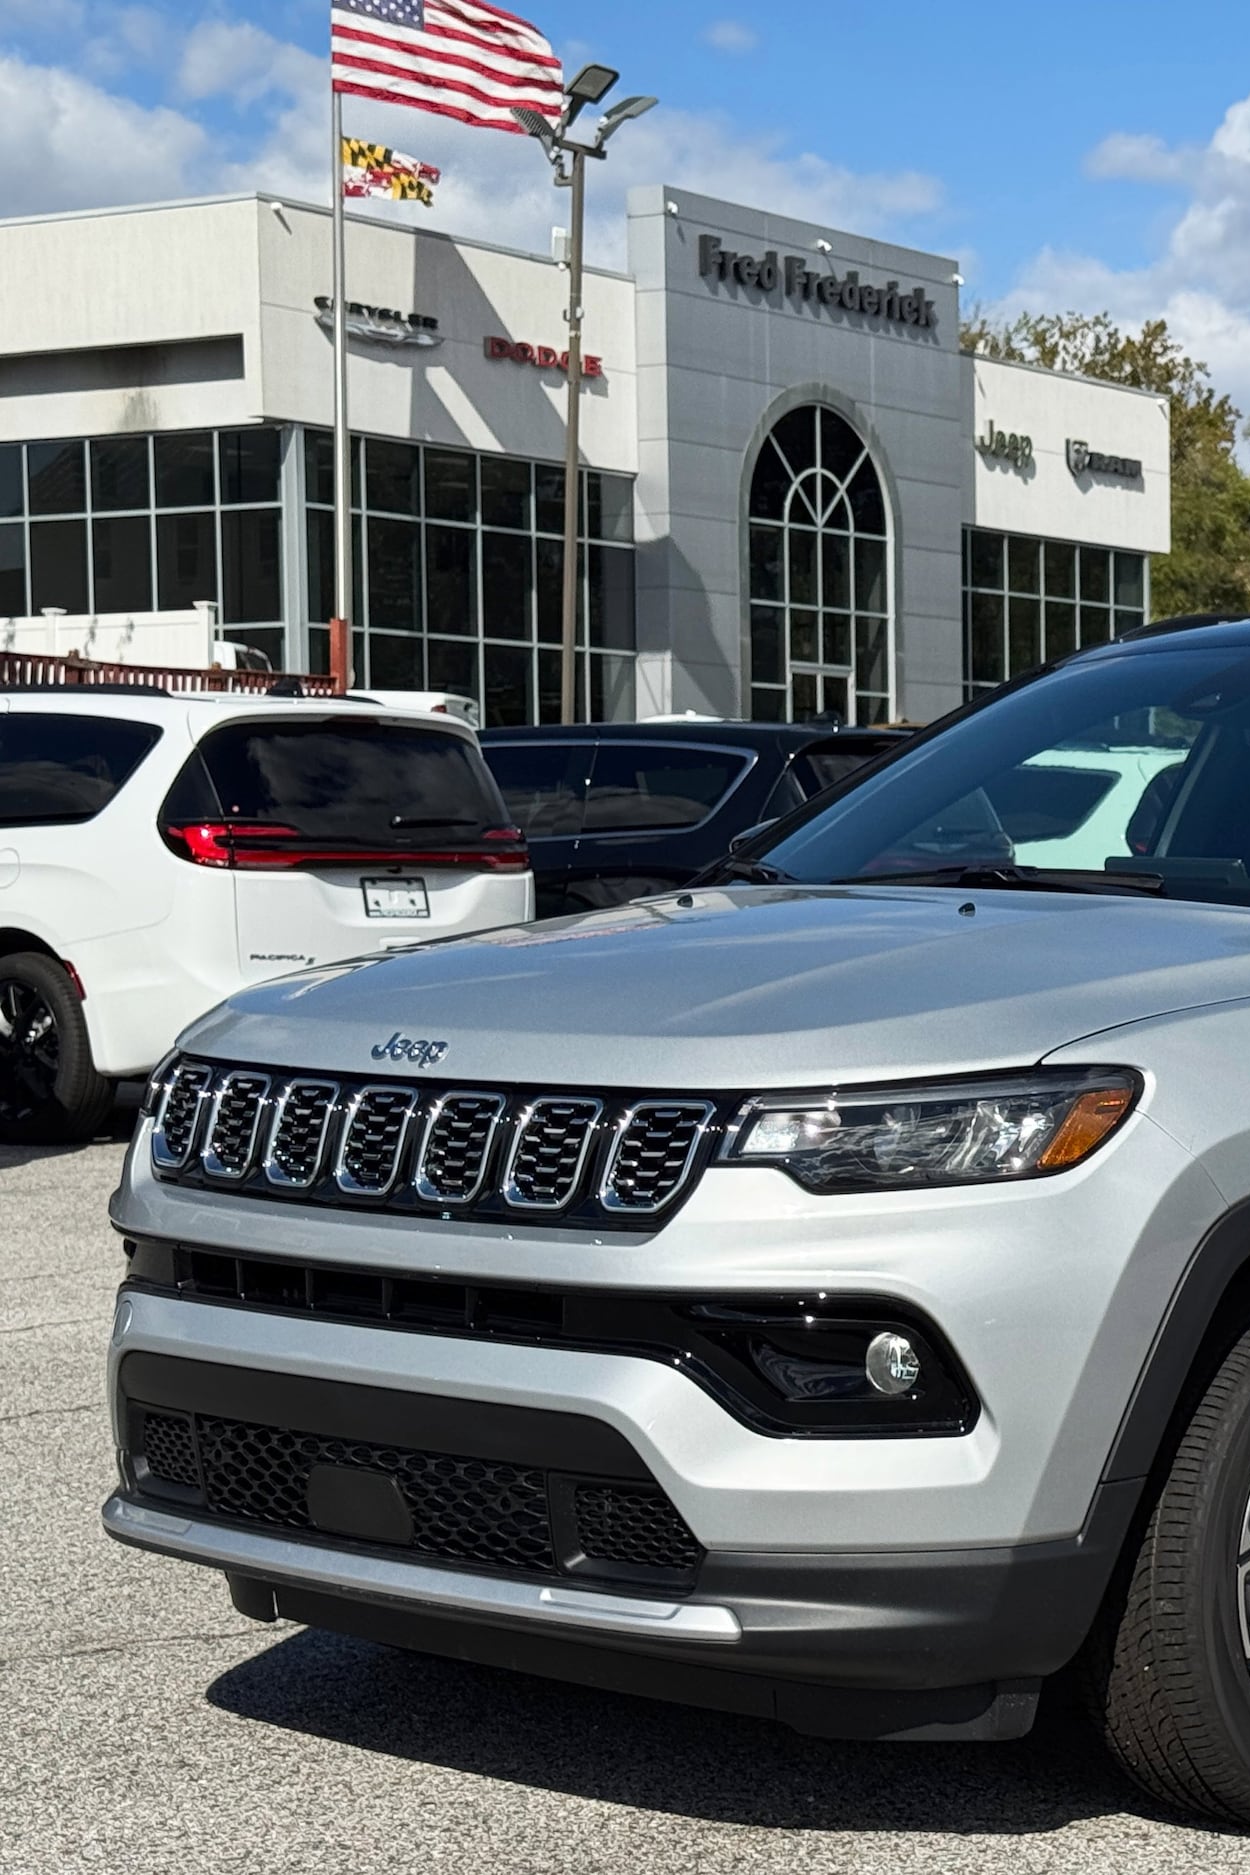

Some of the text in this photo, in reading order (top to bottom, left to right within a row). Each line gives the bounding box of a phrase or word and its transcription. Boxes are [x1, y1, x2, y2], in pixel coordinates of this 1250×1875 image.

[698, 234, 938, 328] Fred Frederick
[977, 419, 1033, 469] Jeep
[249, 953, 305, 961] PACIFICA
[371, 1031, 449, 1069] Jeep
